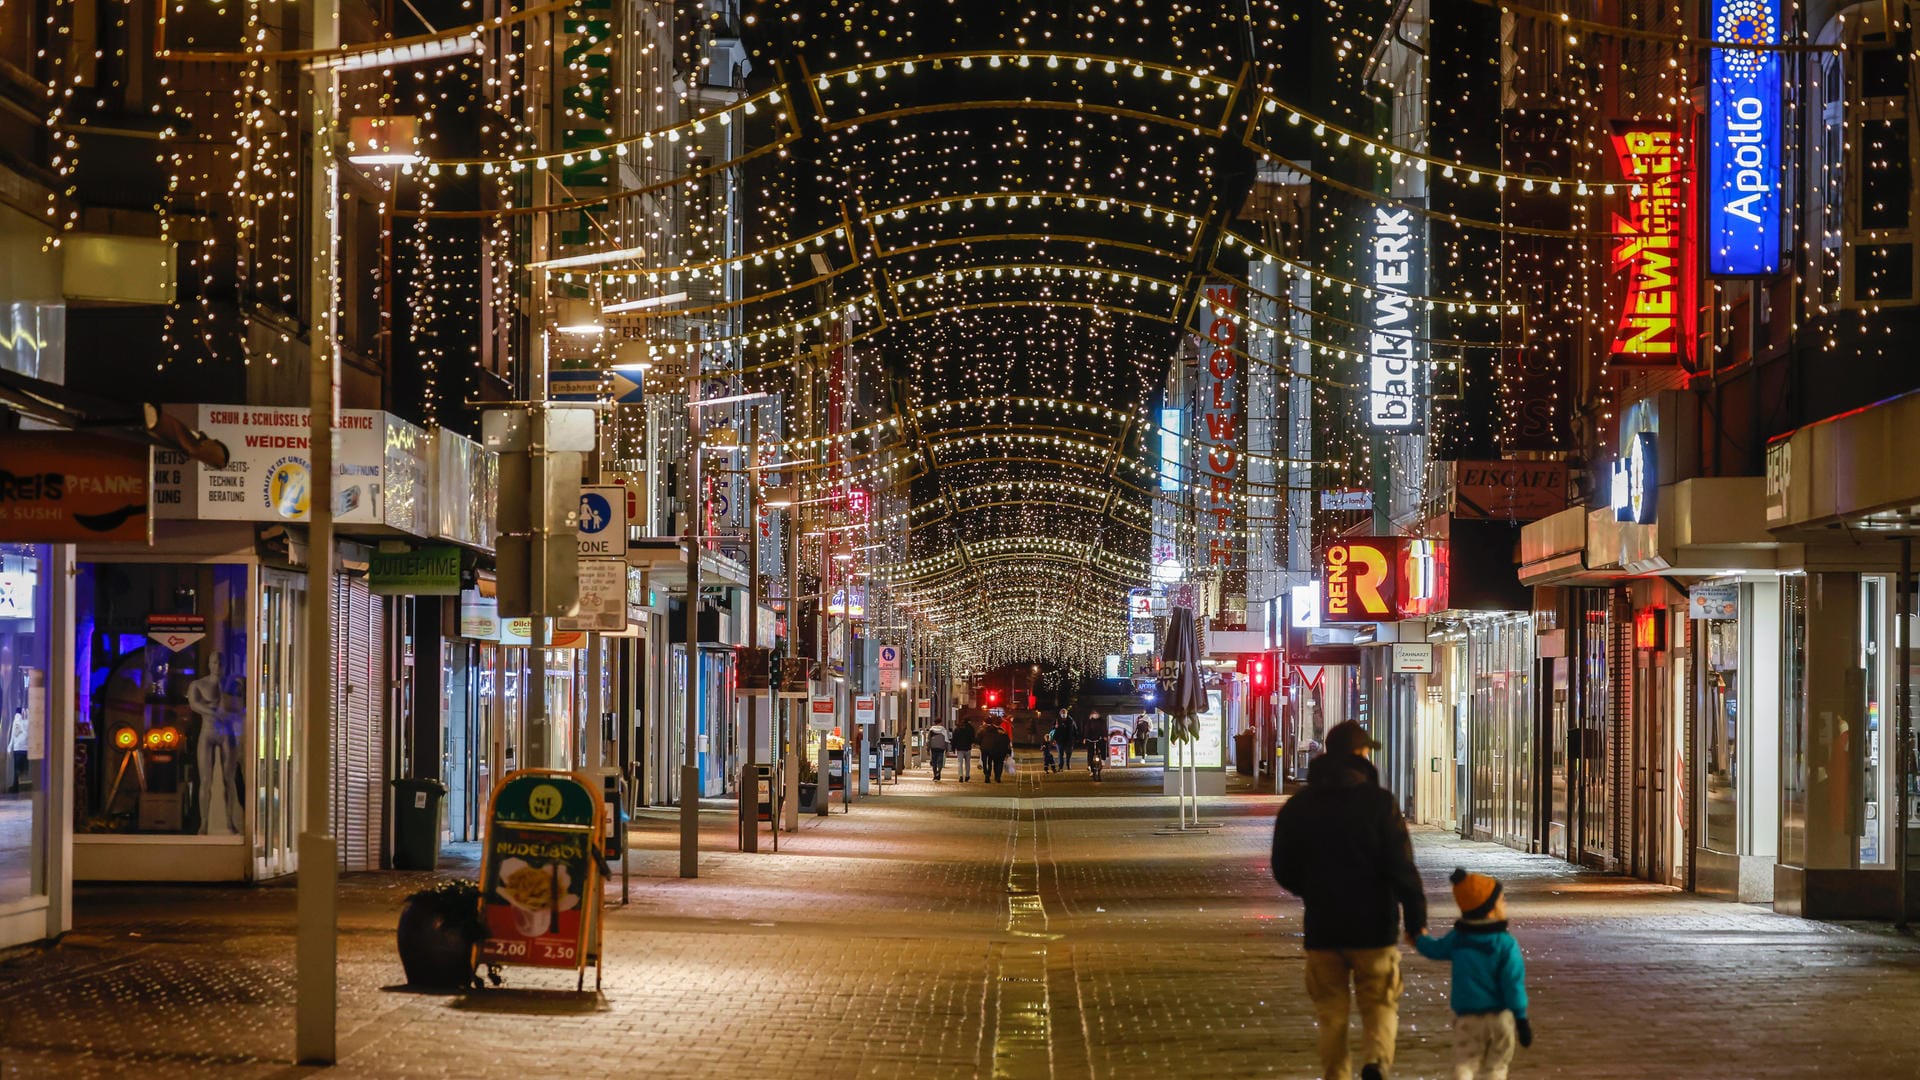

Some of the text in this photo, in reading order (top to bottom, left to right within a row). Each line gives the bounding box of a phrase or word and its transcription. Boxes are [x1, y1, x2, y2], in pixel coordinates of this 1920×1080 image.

[1727, 97, 1770, 224] Apollo
[1614, 131, 1671, 353] NEW YORKER
[1375, 207, 1409, 419] back WERK
[210, 410, 240, 425] SCHUH
[243, 411, 250, 425] &
[252, 410, 299, 427] SCHLÜSSEL
[1205, 287, 1238, 566] WOOLWORTH
[208, 475, 245, 487] TECHNIK &
[208, 490, 245, 502] BERATUNG
[14, 507, 63, 520] SUSHI
[1328, 545, 1348, 614] RENO
[1349, 545, 1390, 614] R
[496, 943, 527, 956] 2,00
[544, 946, 575, 959] 2,50
